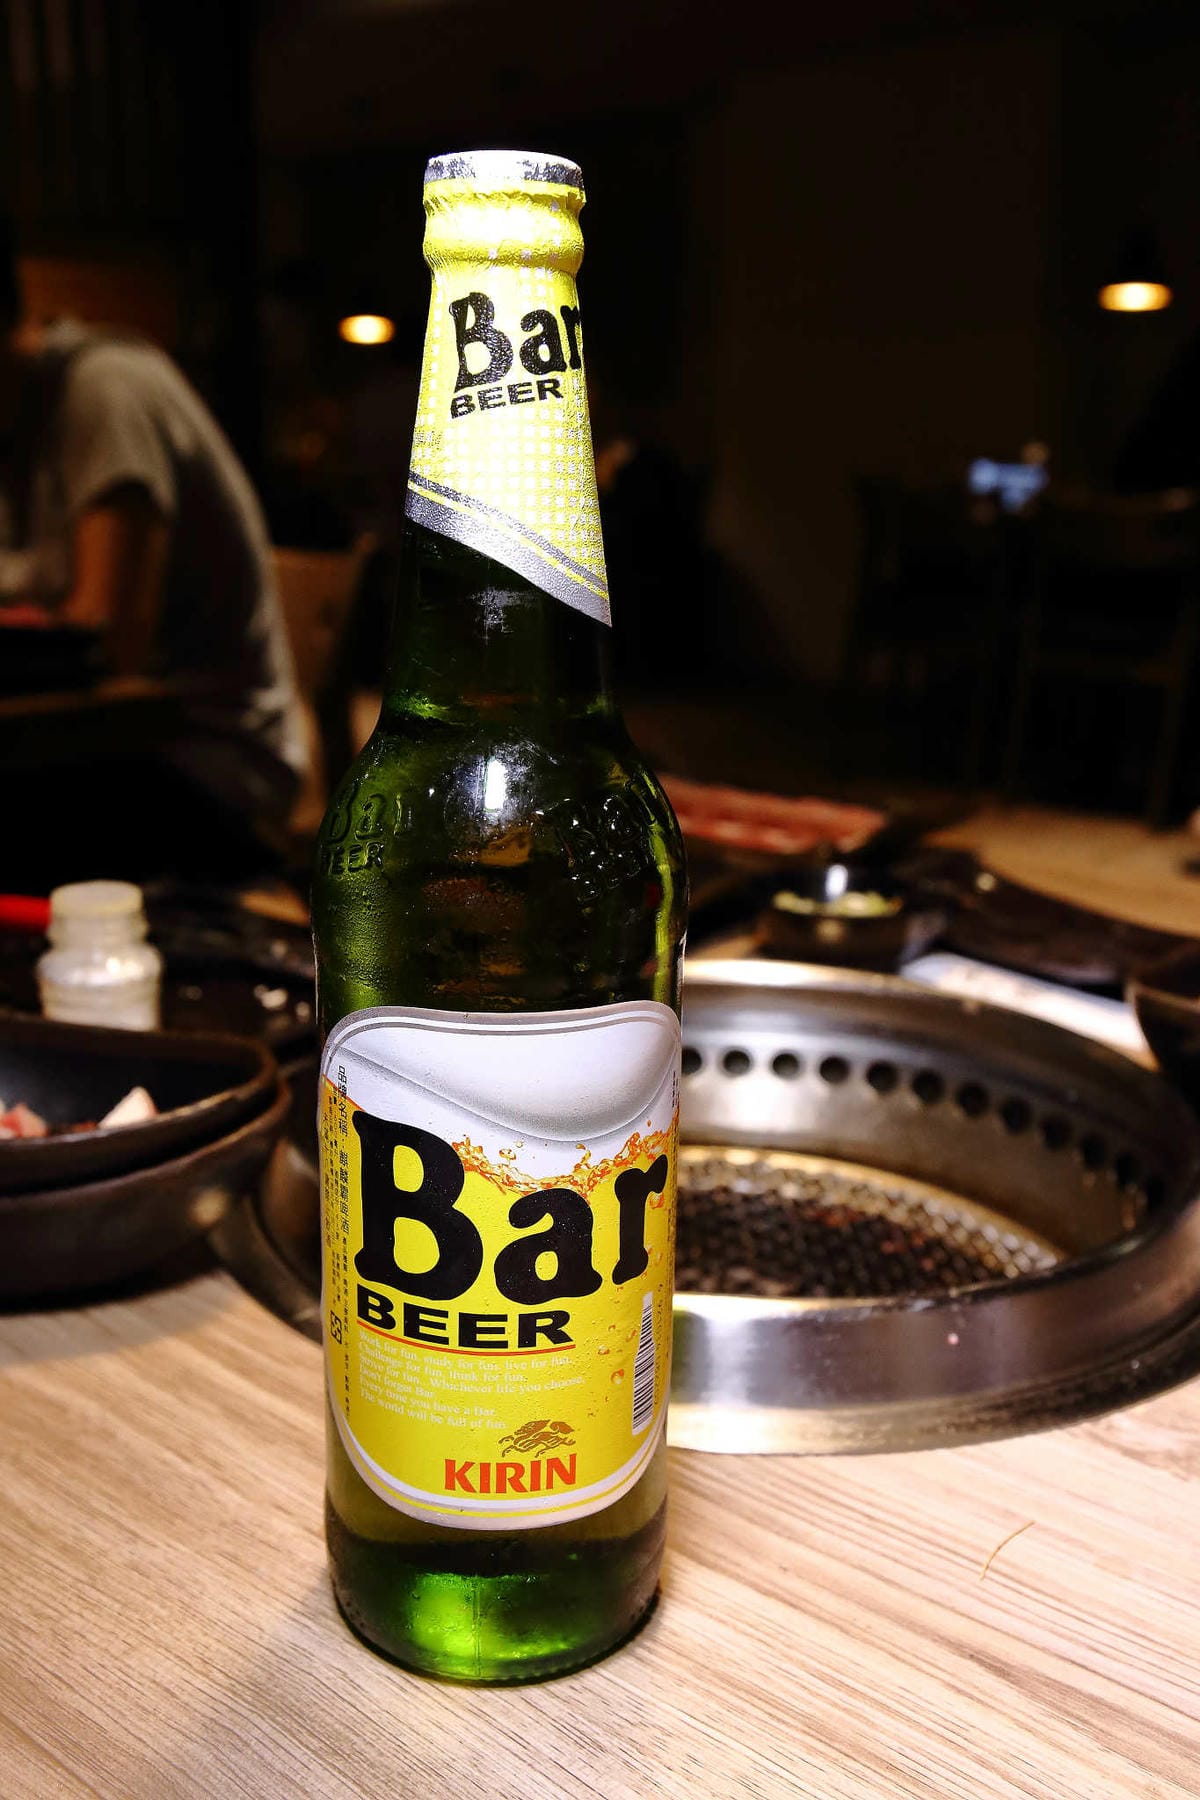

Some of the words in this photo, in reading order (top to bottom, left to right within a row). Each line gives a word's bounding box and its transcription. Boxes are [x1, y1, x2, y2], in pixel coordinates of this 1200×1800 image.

[449, 292, 583, 394] Bar
[450, 378, 564, 420] BEER
[352, 1110, 668, 1306] Bar
[356, 1283, 574, 1349] BEER
[359, 1330, 381, 1349] Work
[384, 1342, 398, 1355] for
[424, 1356, 454, 1369] study
[458, 1358, 473, 1369] for
[505, 1359, 527, 1370] live
[531, 1358, 547, 1369] for
[359, 1342, 402, 1369] Challenge
[406, 1360, 421, 1372] for
[450, 1369, 478, 1382] think
[483, 1371, 499, 1382] for
[359, 1375, 383, 1397] Every
[385, 1389, 407, 1404] time
[409, 1397, 431, 1410] you
[433, 1400, 460, 1414] have
[463, 1407, 470, 1416] a
[383, 1375, 412, 1393] forget
[386, 1366, 400, 1378] for
[430, 1377, 491, 1393] Whichever
[495, 1383, 515, 1393] life
[517, 1384, 541, 1395] you
[360, 1387, 375, 1403] The
[377, 1398, 404, 1416] world
[407, 1408, 427, 1421] will
[430, 1412, 443, 1424] be
[447, 1415, 466, 1428] full
[469, 1418, 483, 1429] of
[444, 1453, 577, 1494] KIRIN
